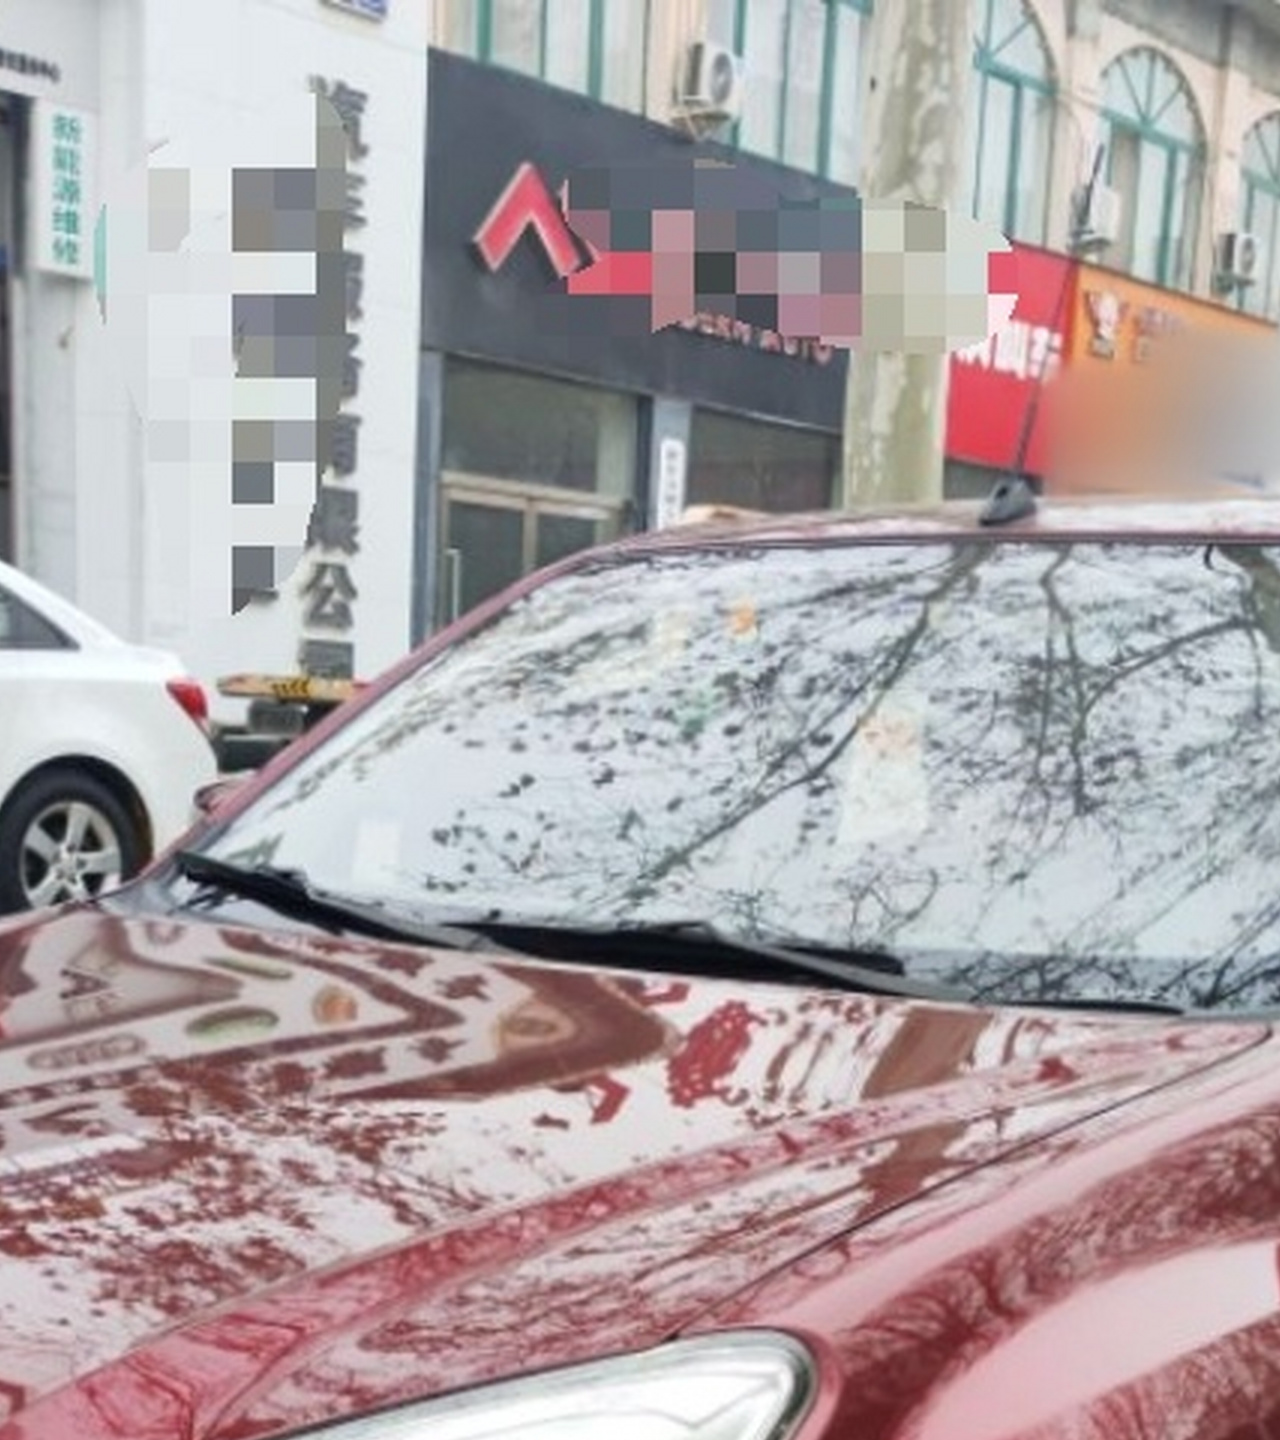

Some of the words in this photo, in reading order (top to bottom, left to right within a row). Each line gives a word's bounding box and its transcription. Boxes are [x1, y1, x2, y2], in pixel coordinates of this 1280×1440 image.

[52, 114, 81, 264] 新能源维修
